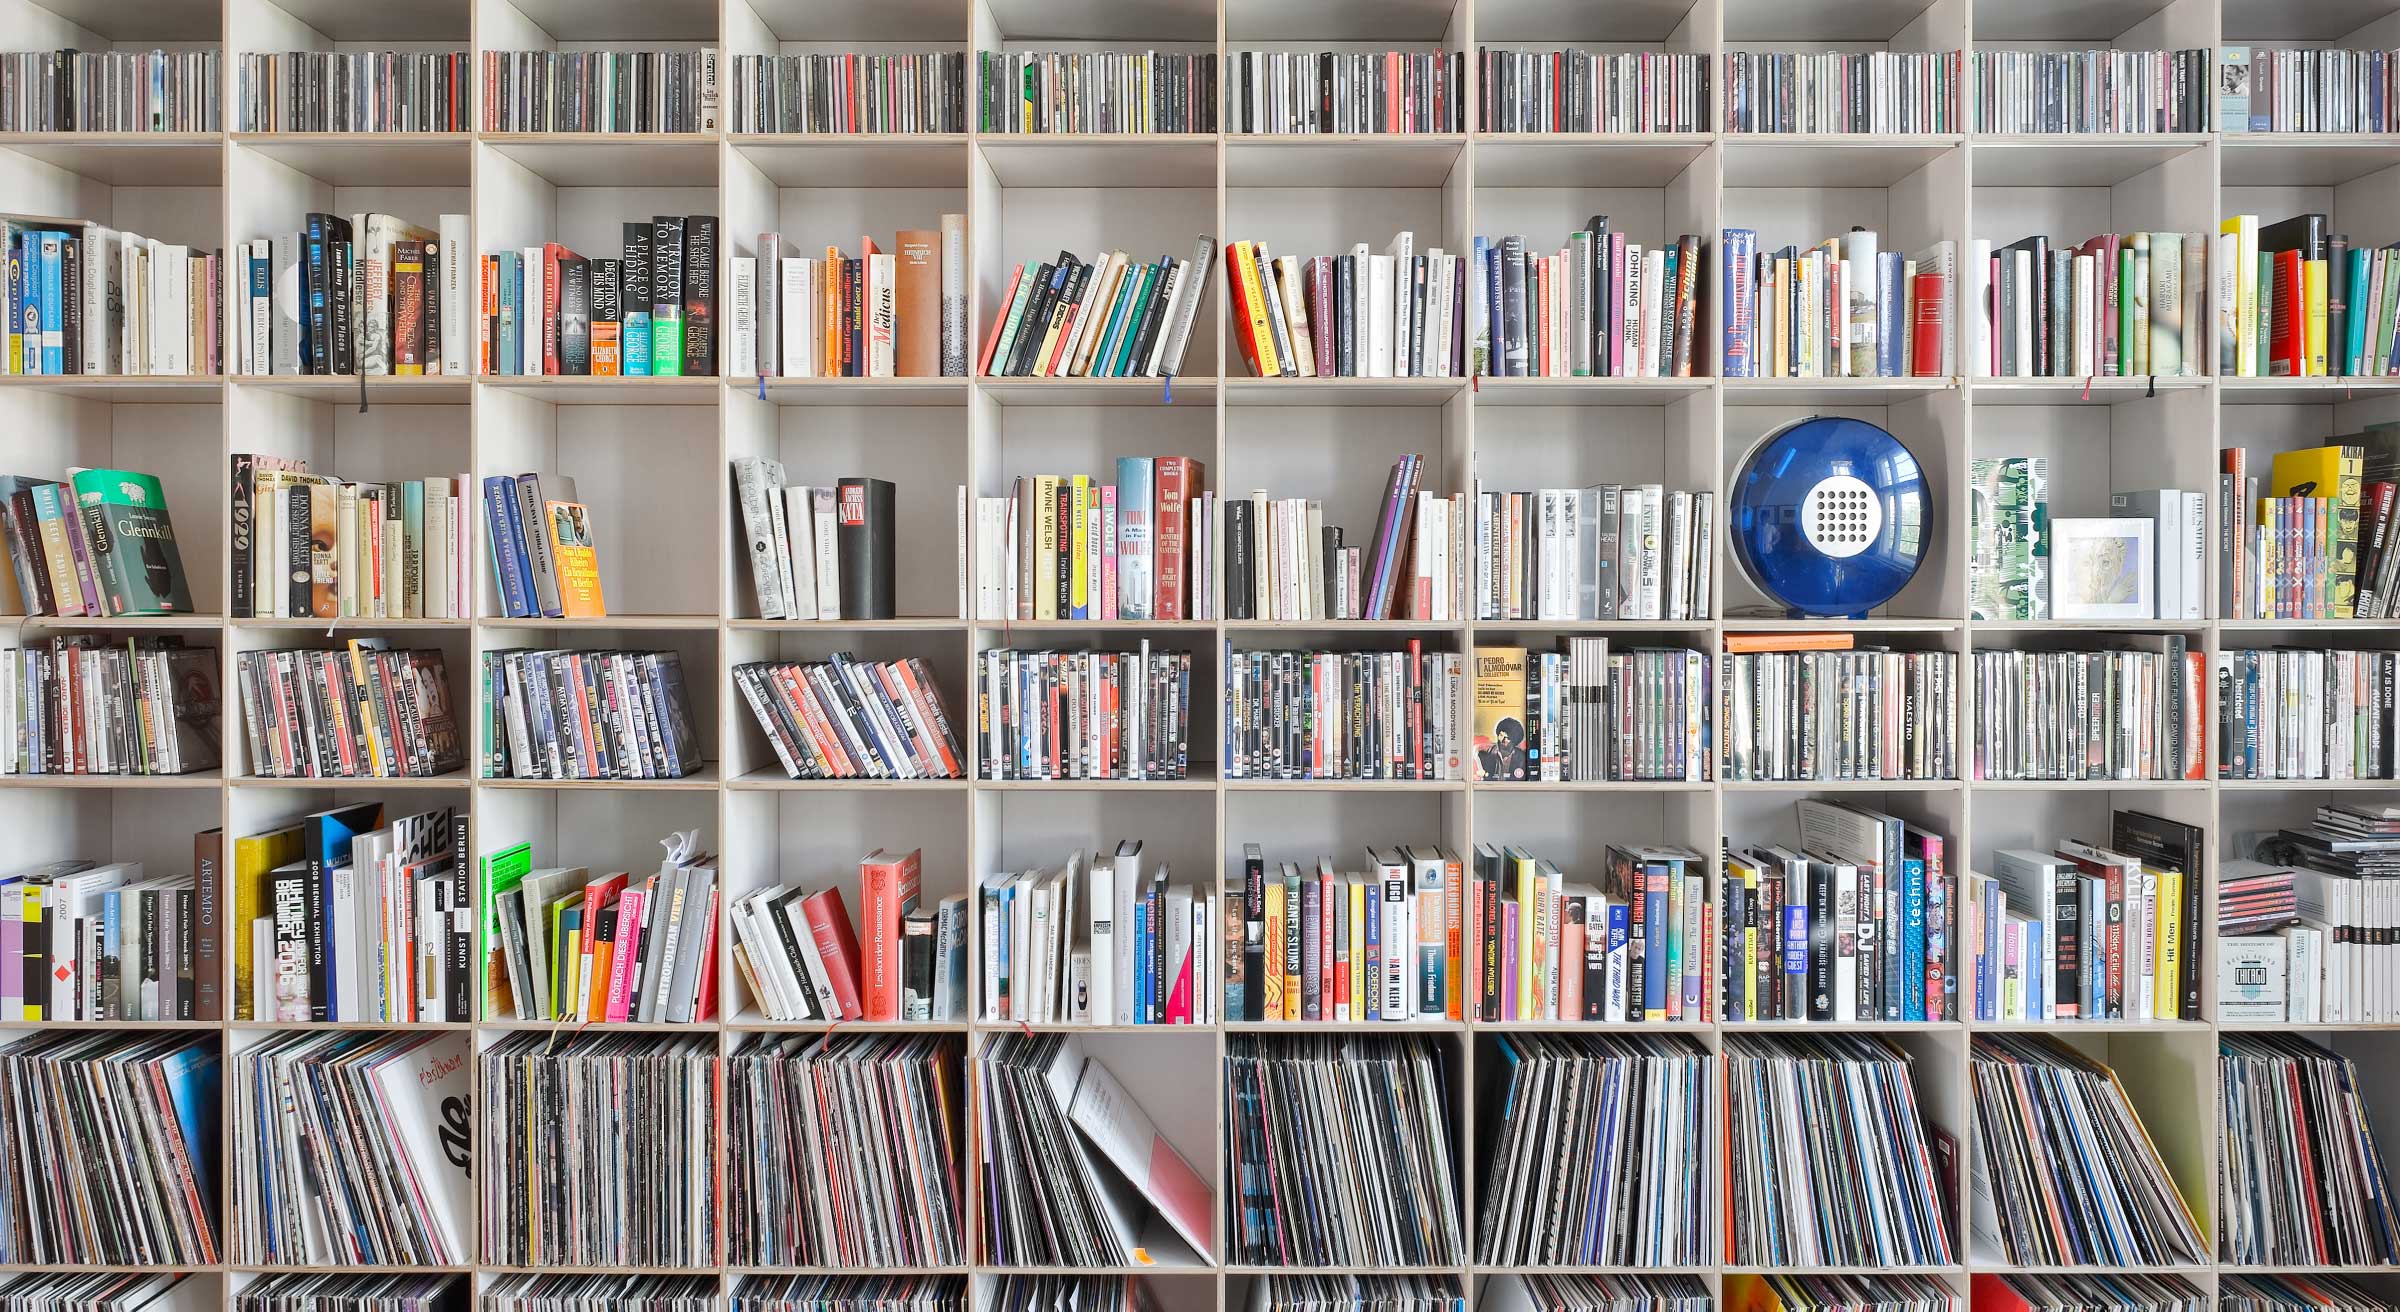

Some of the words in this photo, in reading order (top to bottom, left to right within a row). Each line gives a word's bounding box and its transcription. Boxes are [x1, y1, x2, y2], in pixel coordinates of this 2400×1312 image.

[657, 222, 667, 238] TO
[669, 222, 679, 233] A
[691, 235, 700, 245] HE
[702, 223, 710, 244] WHAT
[88, 234, 96, 266] Douglas
[638, 245, 648, 282] PLACE
[690, 247, 699, 268] SHOT
[700, 246, 710, 268] CAME
[1630, 250, 1639, 274] JOHN
[355, 259, 364, 305] Middlesex
[594, 272, 603, 288] HIS
[605, 262, 615, 302] DECEPTION
[626, 245, 636, 292] HIDING
[656, 245, 667, 300] MEMORY
[669, 242, 680, 298] TRAITOR
[689, 270, 698, 285] HER
[1681, 251, 1692, 300] Schund
[88, 268, 96, 304] Coupland
[638, 286, 648, 302] OF
[699, 270, 709, 298] BEFORE
[738, 274, 749, 306] ELIZABETH
[1163, 267, 1178, 301] HUXLEY
[1494, 255, 1502, 311] RUSSENDISKO
[1629, 280, 1638, 307] KING
[407, 276, 416, 320] CRIMSON
[594, 290, 604, 310] MIND
[606, 305, 615, 320] ON
[738, 307, 749, 332] GEORGE
[874, 287, 891, 346] Medicus
[407, 322, 417, 348] PETAL
[626, 332, 638, 363] GEORGE
[687, 327, 699, 358] GEORGE
[2341, 447, 2363, 459] AKIRA
[281, 474, 298, 483] DAVID
[299, 476, 322, 485] THOMAS
[41, 488, 55, 515] WHITE
[1044, 481, 1052, 513] IRVINE
[1160, 502, 1182, 513] Wolfe
[1163, 488, 1178, 500] Tom
[300, 495, 308, 529] DONNA
[47, 518, 60, 543] TEETH
[92, 508, 107, 551] Glennkill
[118, 520, 173, 540] Glennkill
[1044, 516, 1052, 550] WELSH
[1105, 506, 1115, 556] WOLFE
[300, 533, 309, 566] TARTT
[55, 553, 67, 578] ZADIE
[60, 582, 73, 608] SMITH
[1484, 656, 1504, 665] PEDRO
[2172, 711, 2178, 722] OF
[1390, 868, 1400, 879] NO
[1635, 871, 1644, 895] JERRY
[202, 858, 213, 926] ARTEMPO
[1389, 881, 1399, 901] LOGO
[1447, 867, 1458, 930] FREAKONOMICS
[1910, 867, 1921, 926] techno
[276, 880, 290, 941] BIENNIAL
[290, 879, 305, 940] WHITNEY
[1287, 892, 1298, 928] PLANET
[1287, 892, 1298, 928] PLANET
[1591, 914, 1602, 923] BILL
[1634, 897, 1644, 924] SPRINGER
[656, 924, 679, 1006] METROPOLITAN
[671, 888, 684, 922] VIEWS
[1858, 923, 1874, 951] DJ
[2007, 932, 2016, 958] House
[278, 940, 296, 986] 2006
[1287, 935, 1298, 971] SLUMS
[1287, 935, 1298, 971] SLUMS
[1612, 952, 1621, 966] THE
[1389, 958, 1400, 986] NAOMI
[1612, 966, 1621, 988] THIRD
[1632, 963, 1642, 1006] RINGMASTER!
[1863, 978, 1870, 988] MY
[2235, 968, 2266, 985] CHICAGO
[1389, 988, 1400, 1009] KLEIN
[1612, 988, 1621, 1008] WAVE
